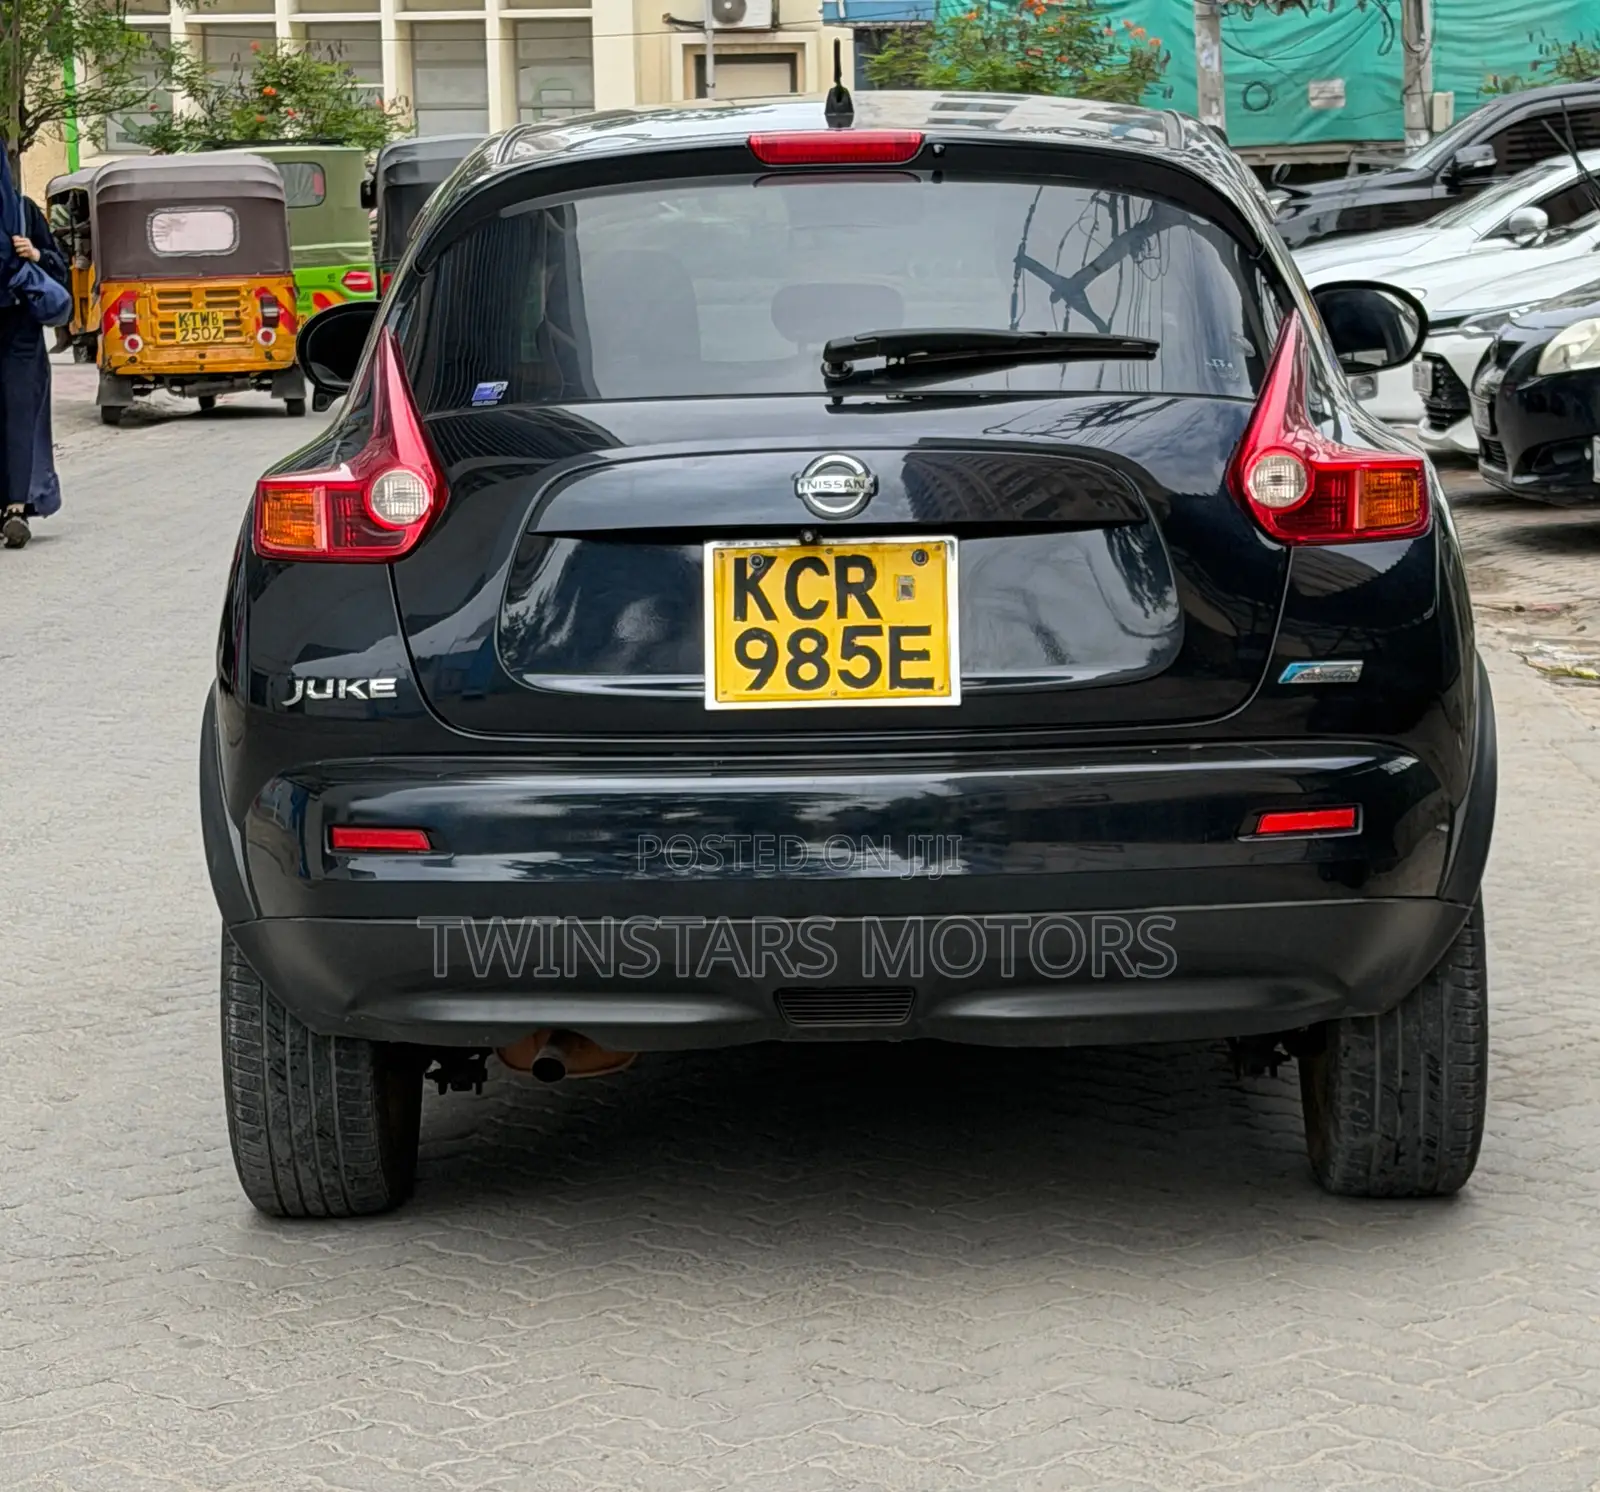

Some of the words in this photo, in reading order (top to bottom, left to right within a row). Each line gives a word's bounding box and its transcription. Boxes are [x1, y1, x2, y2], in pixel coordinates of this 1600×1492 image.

[807, 480, 865, 490] NISSAN
[733, 554, 883, 622] KCR
[734, 624, 935, 691] 985E
[281, 678, 398, 707] JUKE
